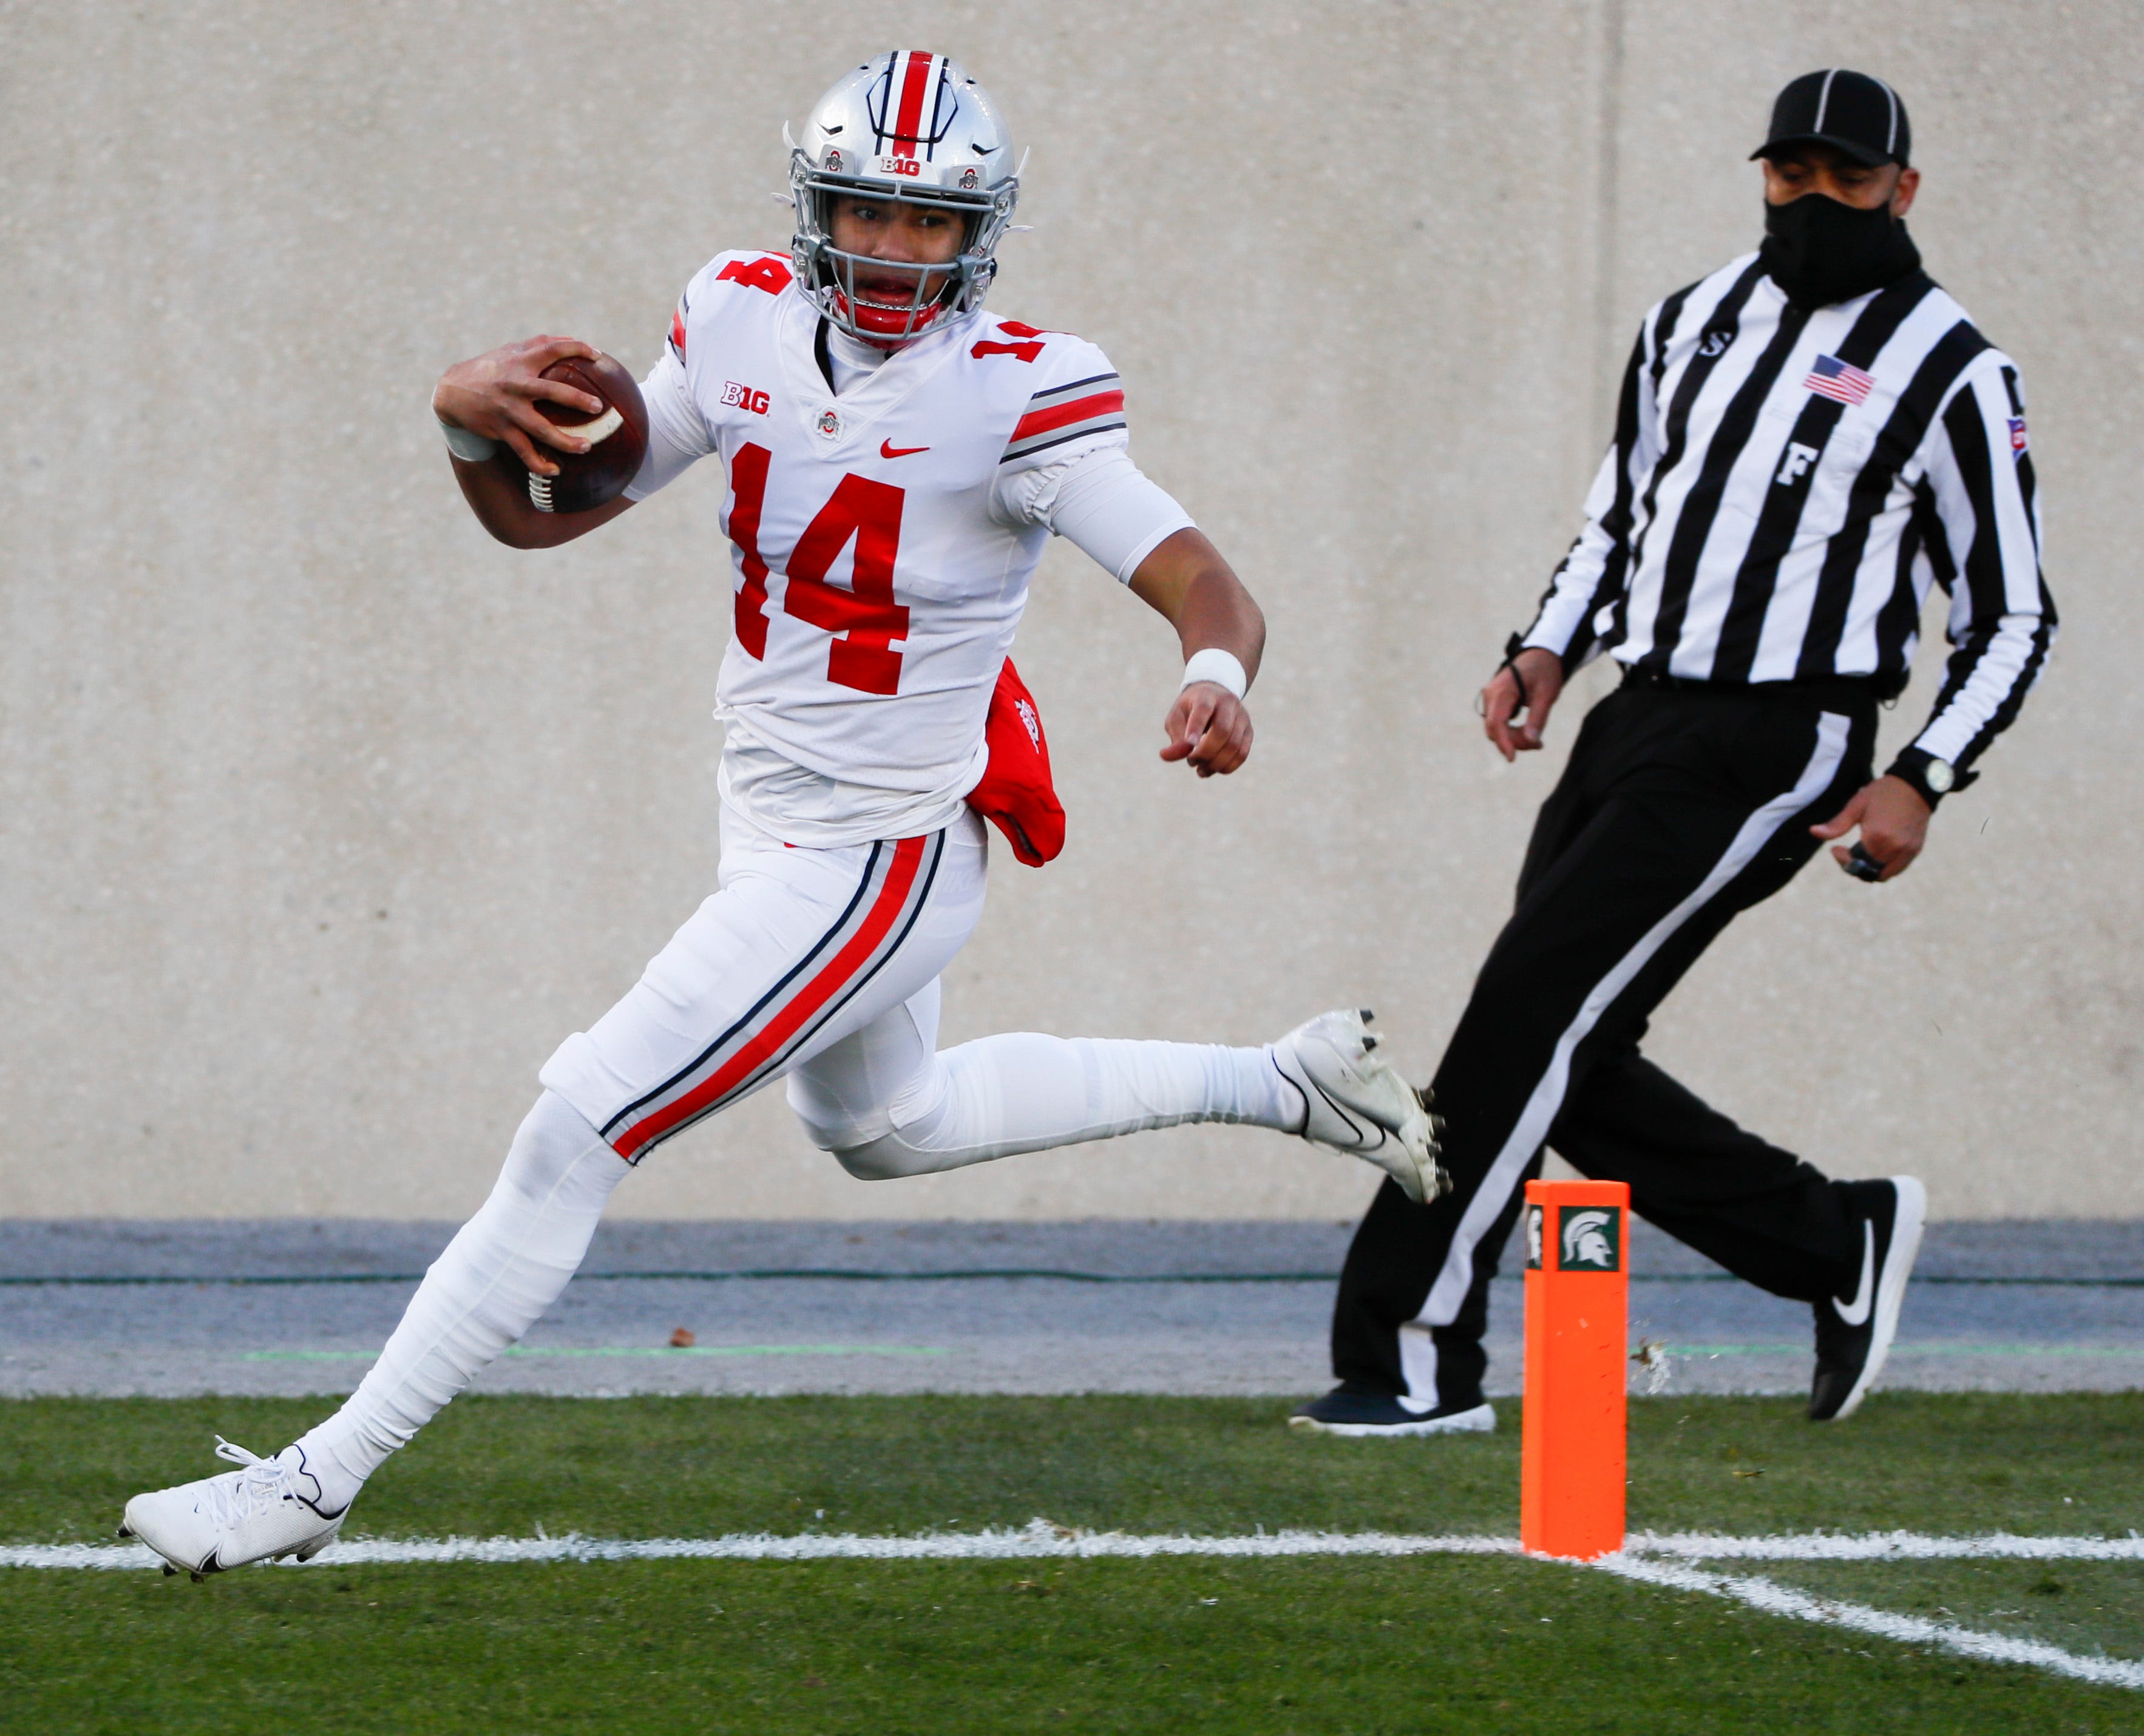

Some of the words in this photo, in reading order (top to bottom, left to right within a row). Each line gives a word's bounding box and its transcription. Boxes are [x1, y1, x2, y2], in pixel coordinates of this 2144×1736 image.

[1700, 331, 1732, 357] S
[1776, 441, 1820, 486] F
[729, 441, 910, 696] 14
